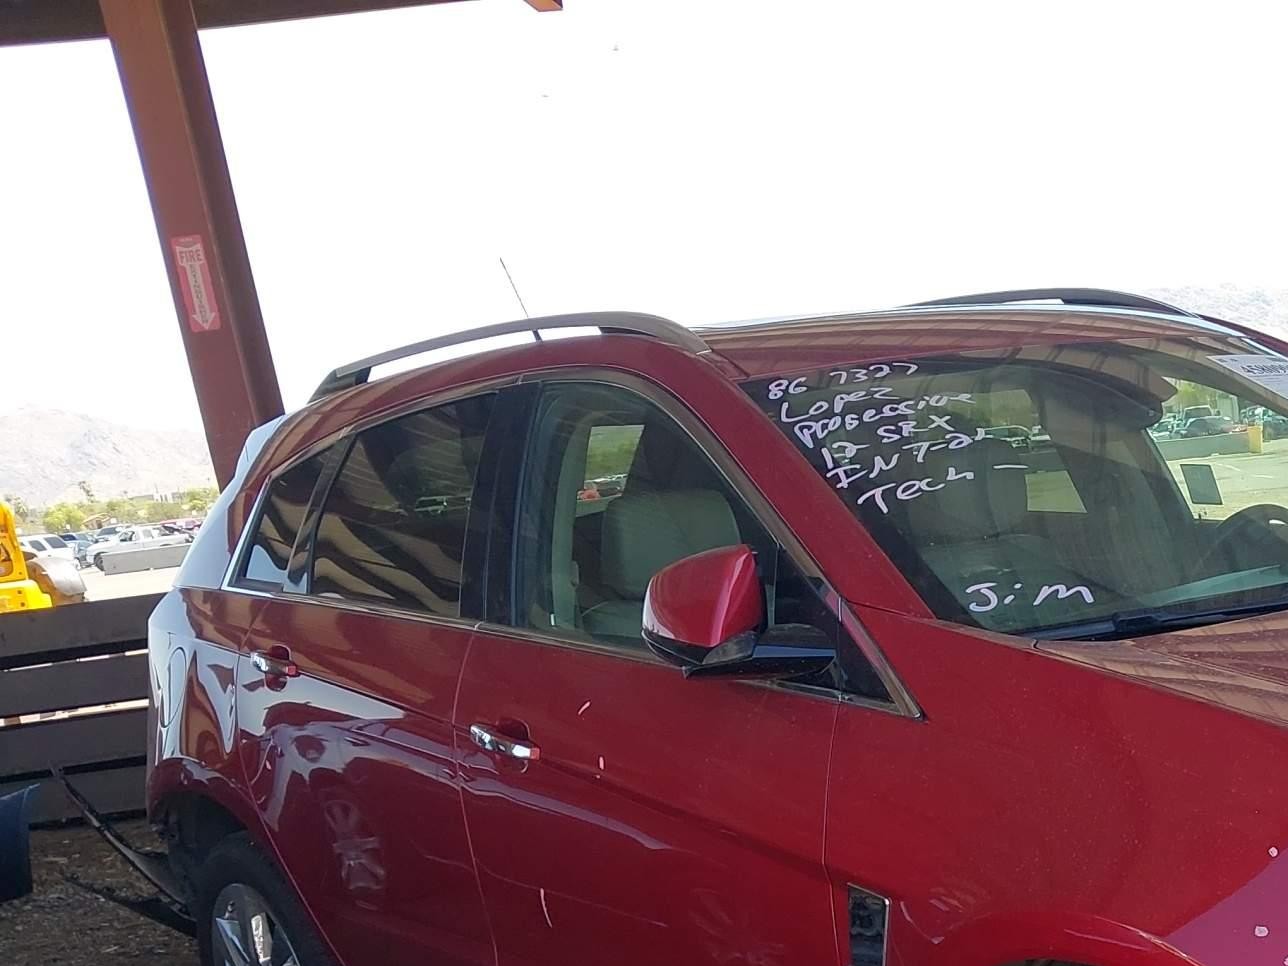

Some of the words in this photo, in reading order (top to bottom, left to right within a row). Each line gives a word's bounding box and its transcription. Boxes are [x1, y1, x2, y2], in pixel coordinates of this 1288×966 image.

[179, 249, 203, 262] FIRE
[768, 376, 808, 400] 86
[829, 362, 919, 385] 7327
